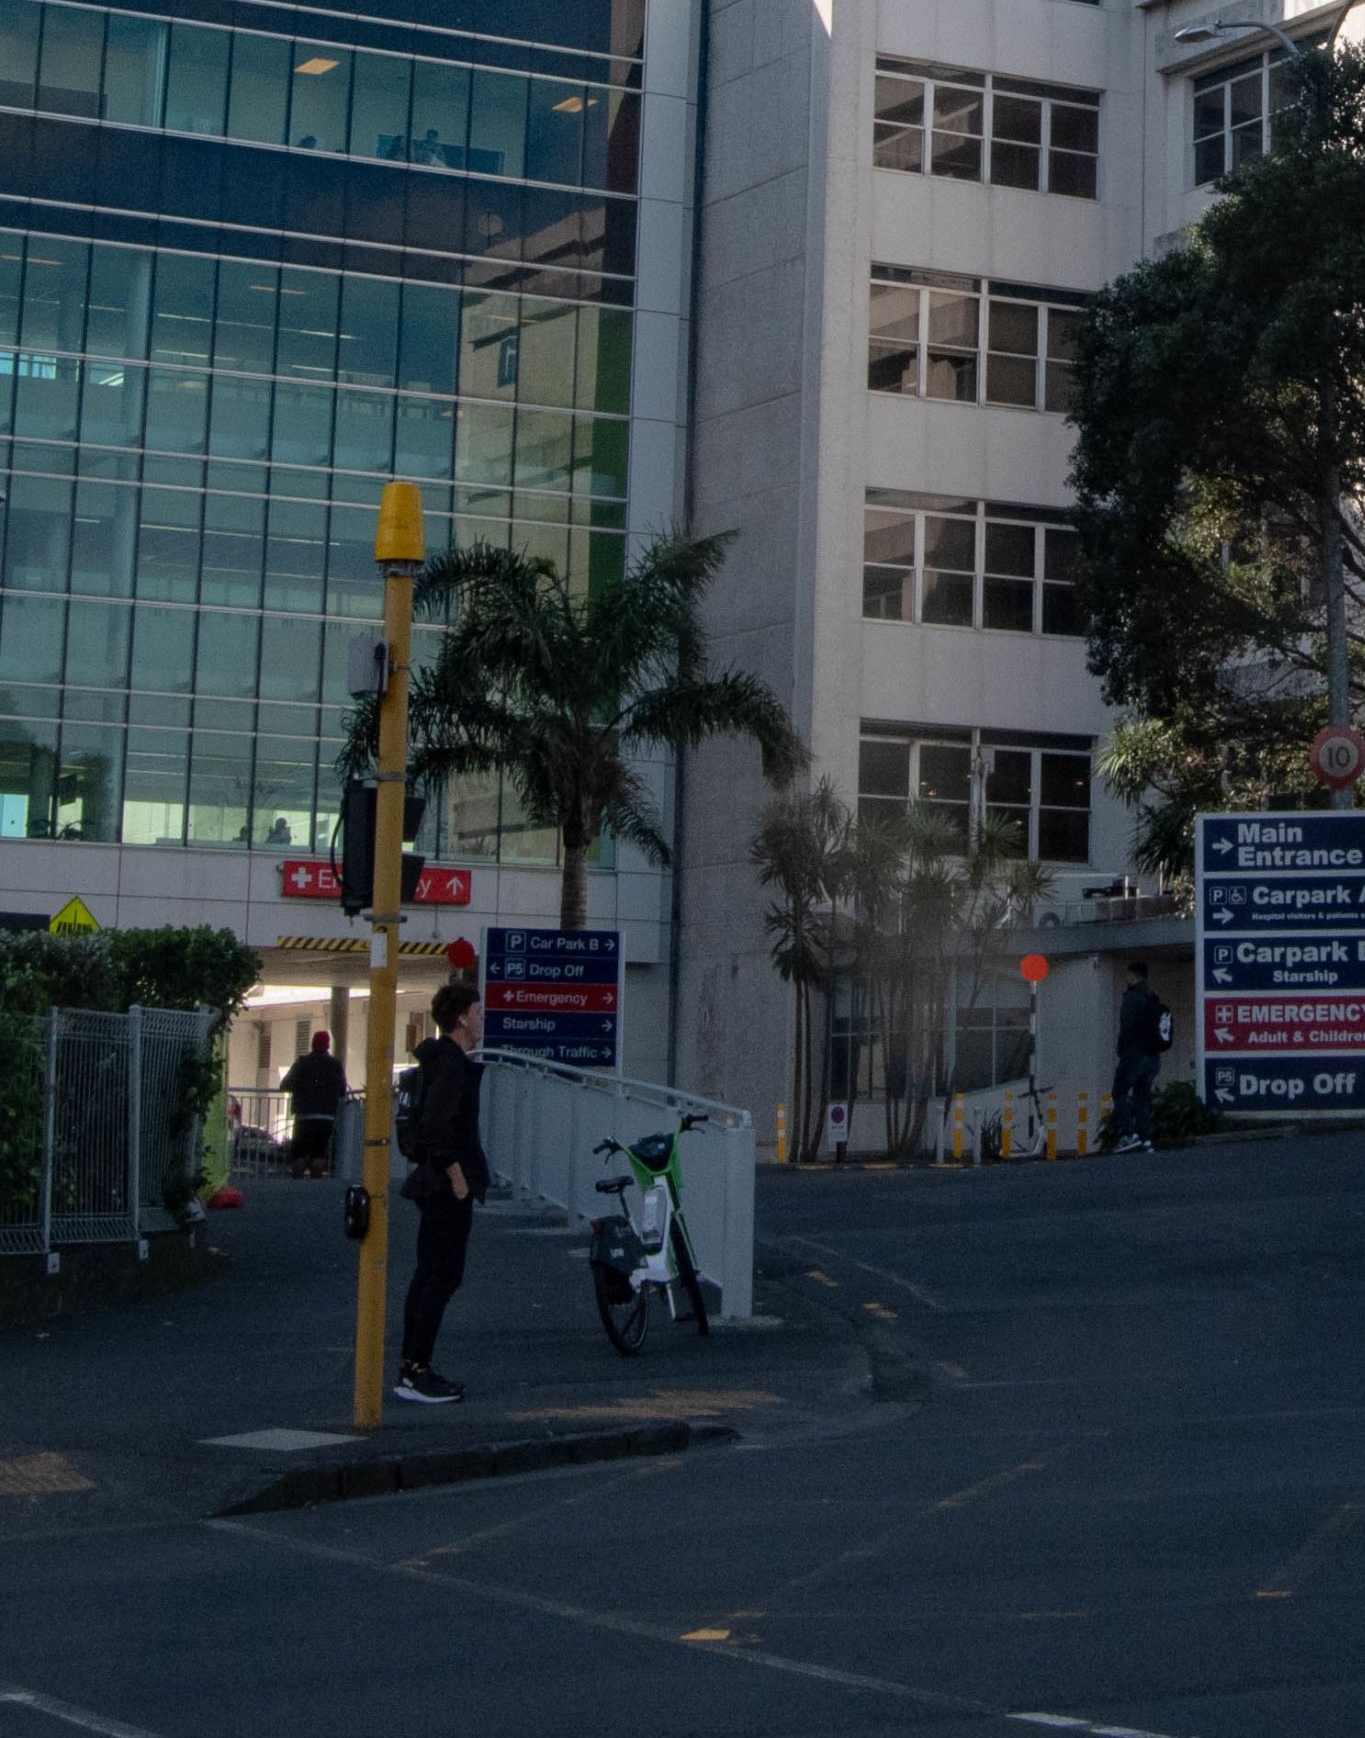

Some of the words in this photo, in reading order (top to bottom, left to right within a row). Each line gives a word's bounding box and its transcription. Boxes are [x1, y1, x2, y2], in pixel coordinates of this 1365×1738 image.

[1327, 746, 1351, 768] 10
[1237, 823, 1303, 844] Main
[1237, 846, 1363, 867] Entrance
[1212, 890, 1224, 902] P
[1252, 884, 1352, 908] Carpark
[1251, 912, 1285, 922] Hospital
[1318, 912, 1325, 921] &
[510, 934, 522, 949] P
[530, 936, 553, 949] Car
[556, 937, 586, 950] Park
[589, 938, 599, 950] B
[1218, 949, 1229, 960] P
[1236, 941, 1349, 968] Carpark
[507, 963, 523, 975] P5
[529, 964, 560, 978] Drop
[564, 964, 584, 977] Off
[1272, 969, 1339, 985] Starship
[516, 991, 588, 1006] Emergency
[502, 1017, 556, 1032] Starship
[1247, 1031, 1288, 1044] Adult
[1293, 1031, 1304, 1043] &
[559, 1046, 598, 1058] Traffic
[1217, 1072, 1233, 1082] P5
[1239, 1074, 1304, 1100] Drop
[1313, 1072, 1356, 1094] Off
